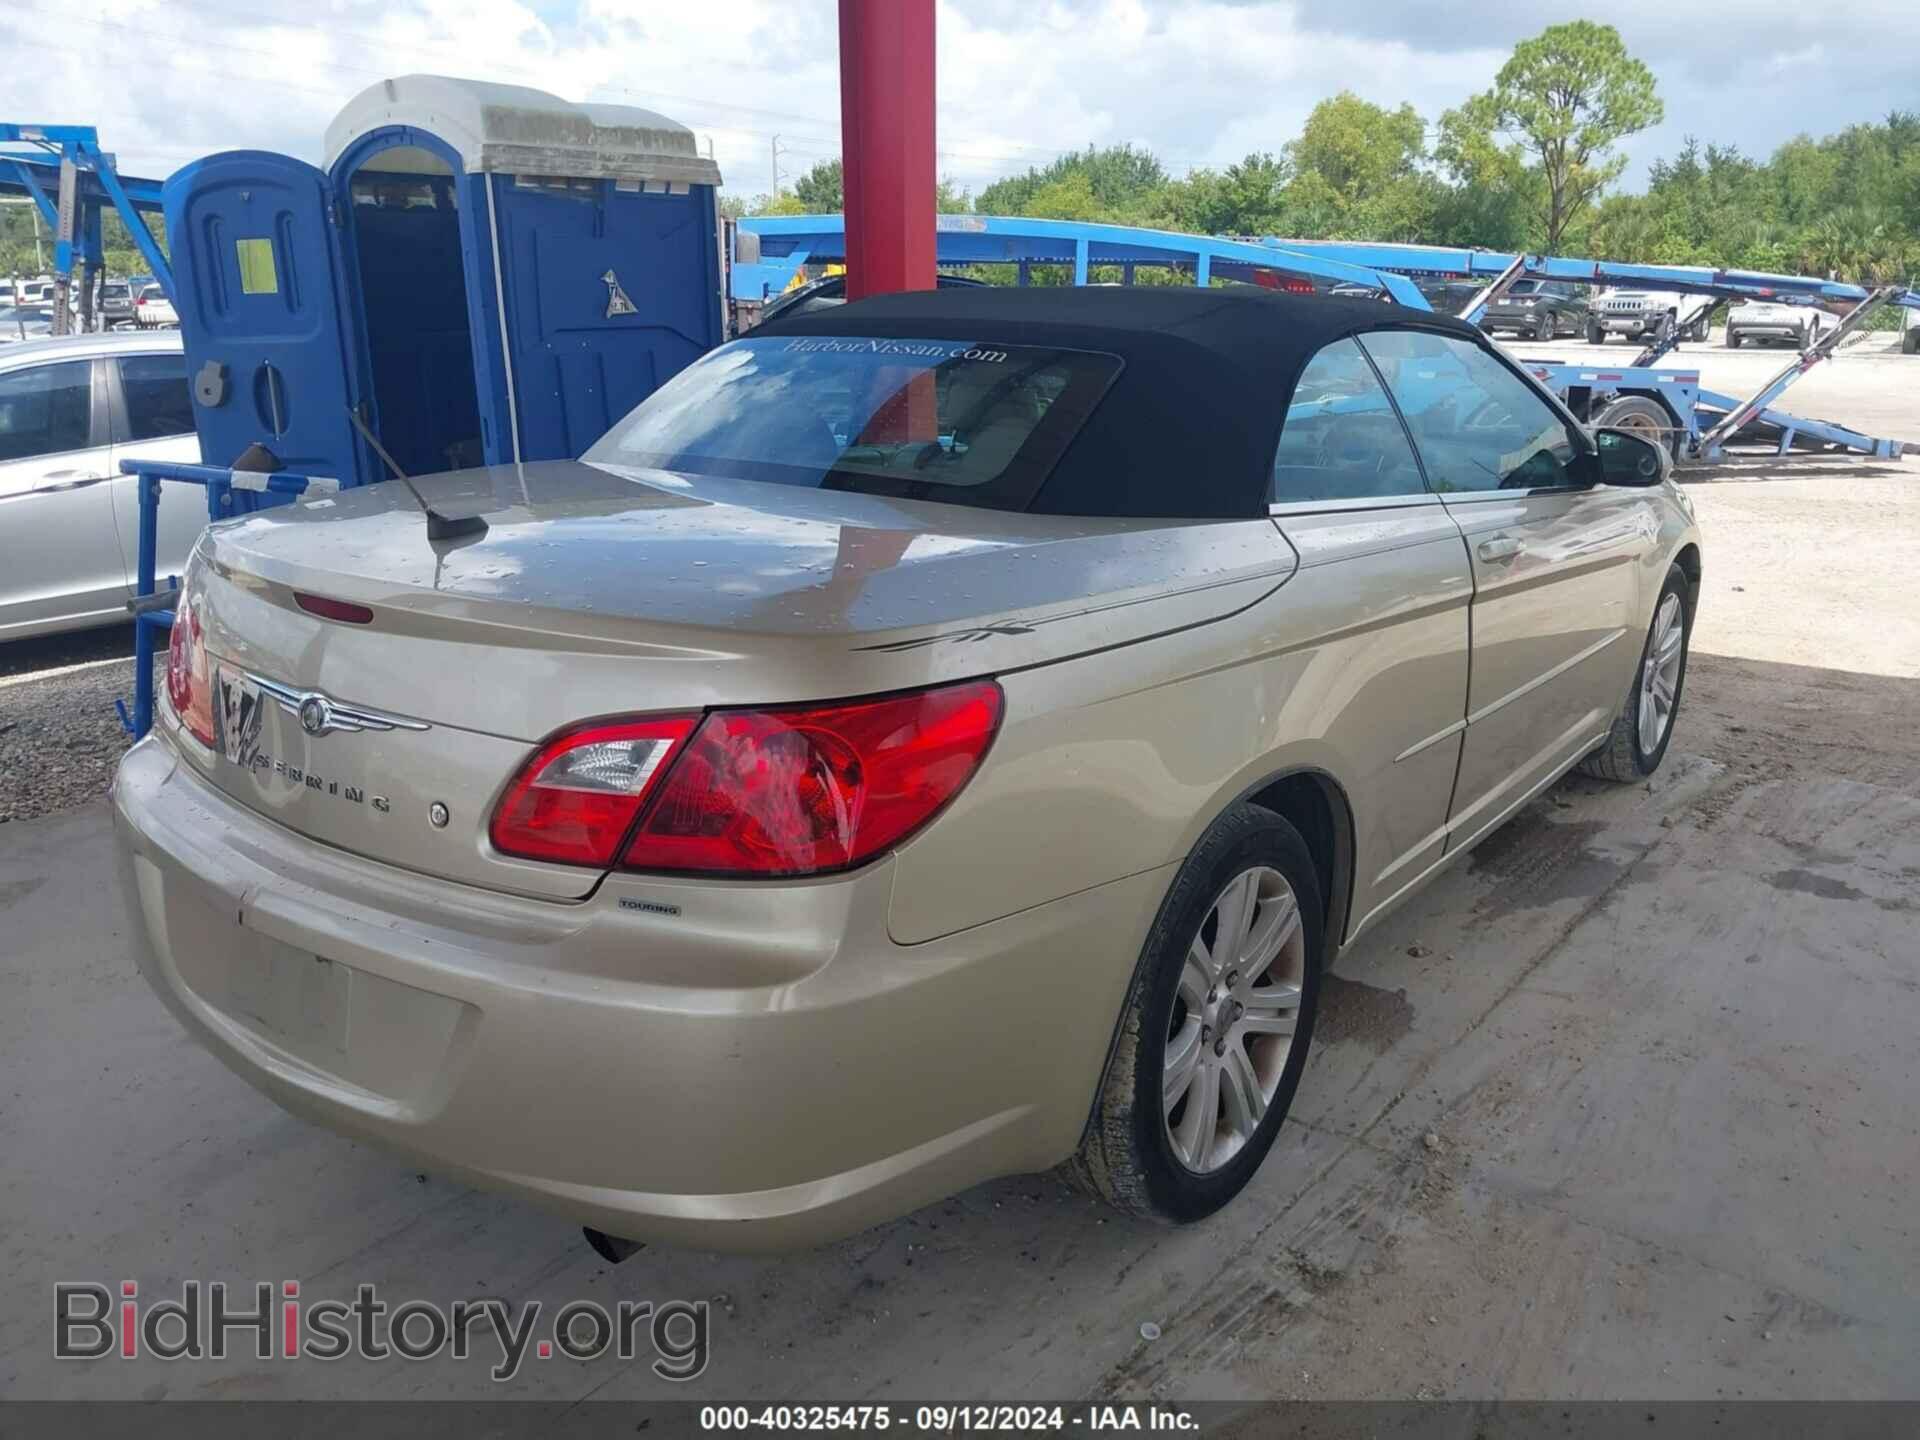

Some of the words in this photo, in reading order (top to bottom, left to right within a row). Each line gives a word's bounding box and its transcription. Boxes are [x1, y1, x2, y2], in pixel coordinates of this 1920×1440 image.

[783, 339, 1007, 363] HarborNissan.com
[256, 755, 390, 812] SEBRING
[620, 900, 678, 914] TOURING
